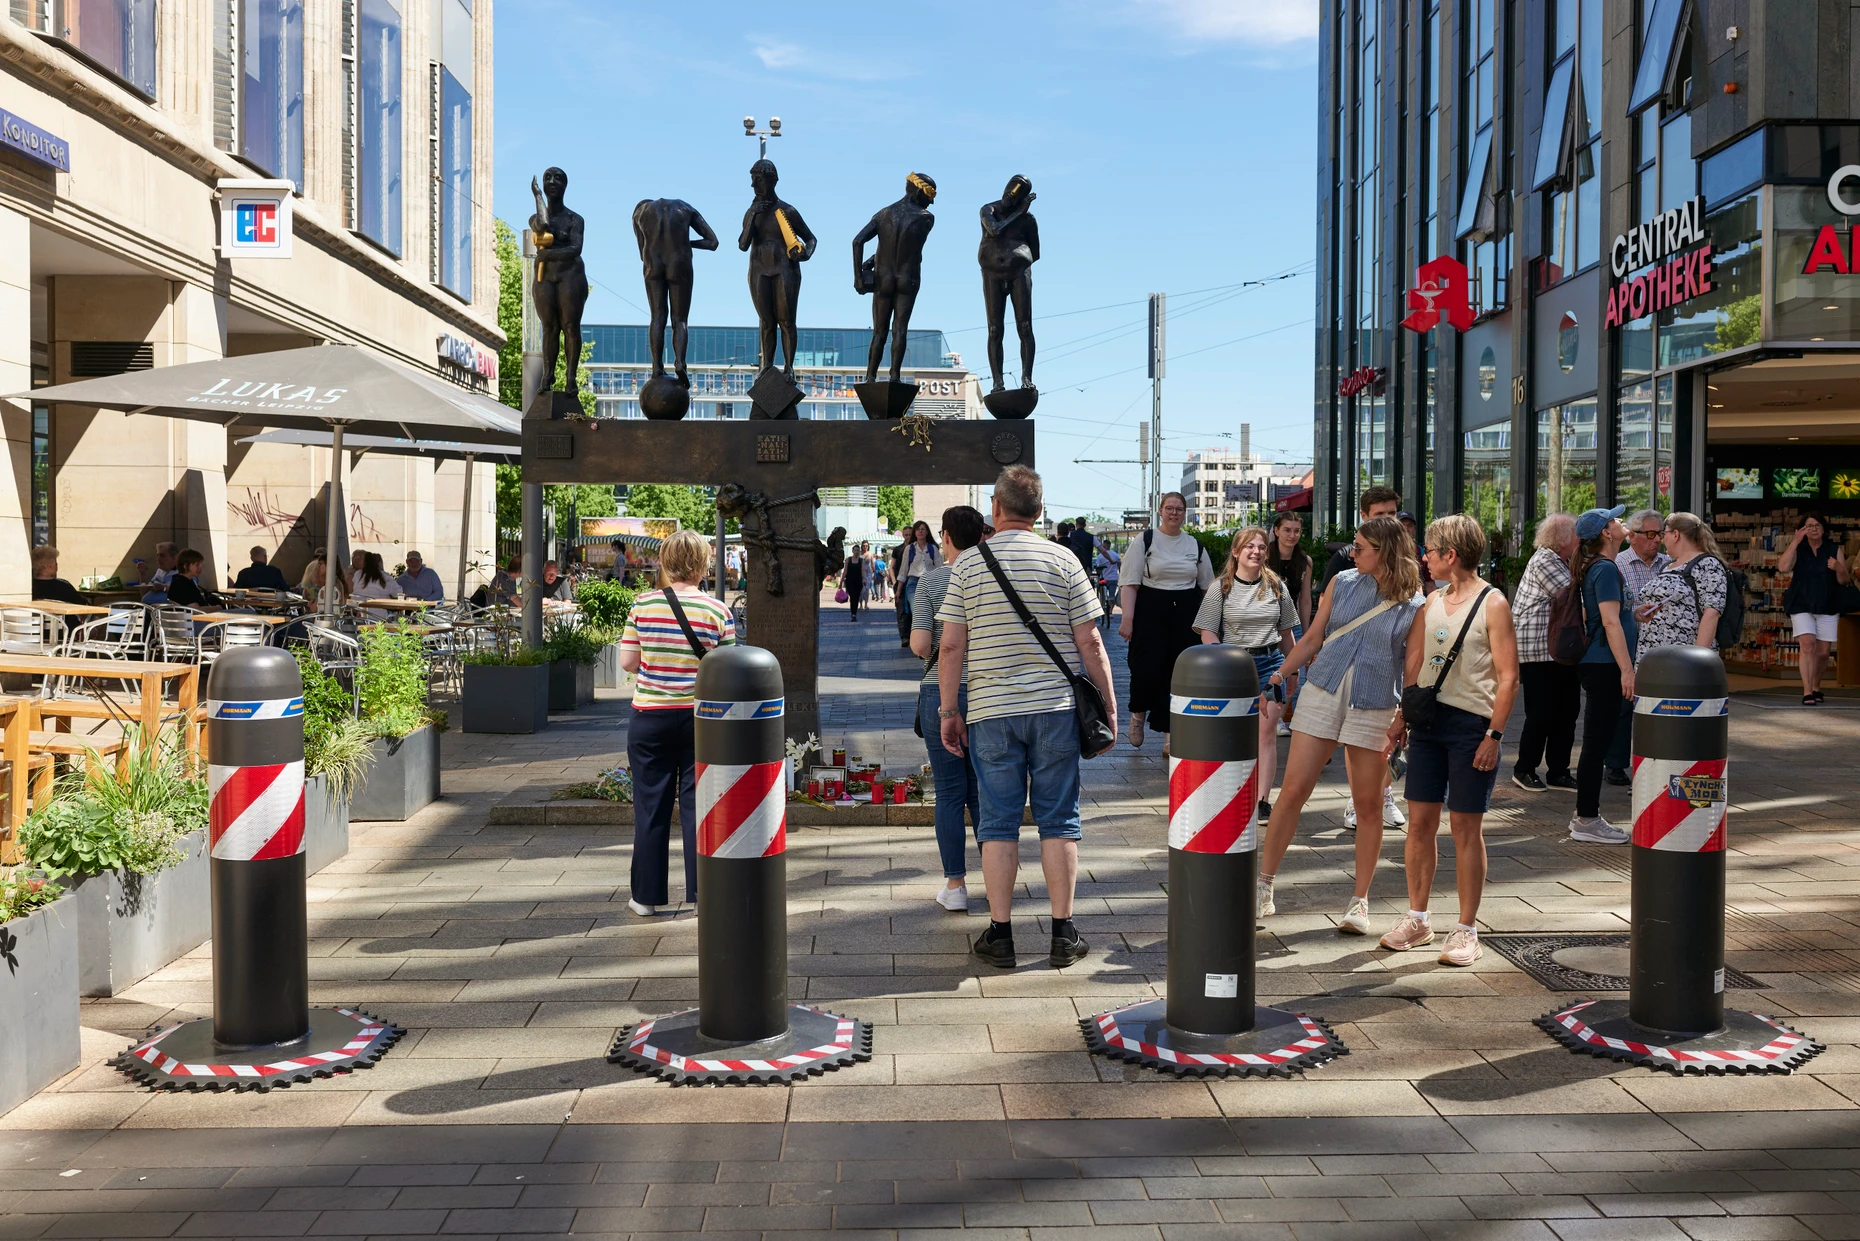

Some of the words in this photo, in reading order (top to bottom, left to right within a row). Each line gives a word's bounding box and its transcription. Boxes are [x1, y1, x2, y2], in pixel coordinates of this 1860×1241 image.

[2, 113, 65, 165] KONDITOR
[1611, 195, 1705, 278] CENTRAL
[1802, 224, 1860, 274] A
[1604, 245, 1712, 330] APOTHEKE
[200, 378, 348, 404] LUKAS
[919, 380, 960, 395] POST
[1512, 375, 1524, 405] 16
[587, 548, 616, 556] FRISC
[1683, 779, 1720, 789] LYNCH
[1690, 789, 1719, 799] MOB
